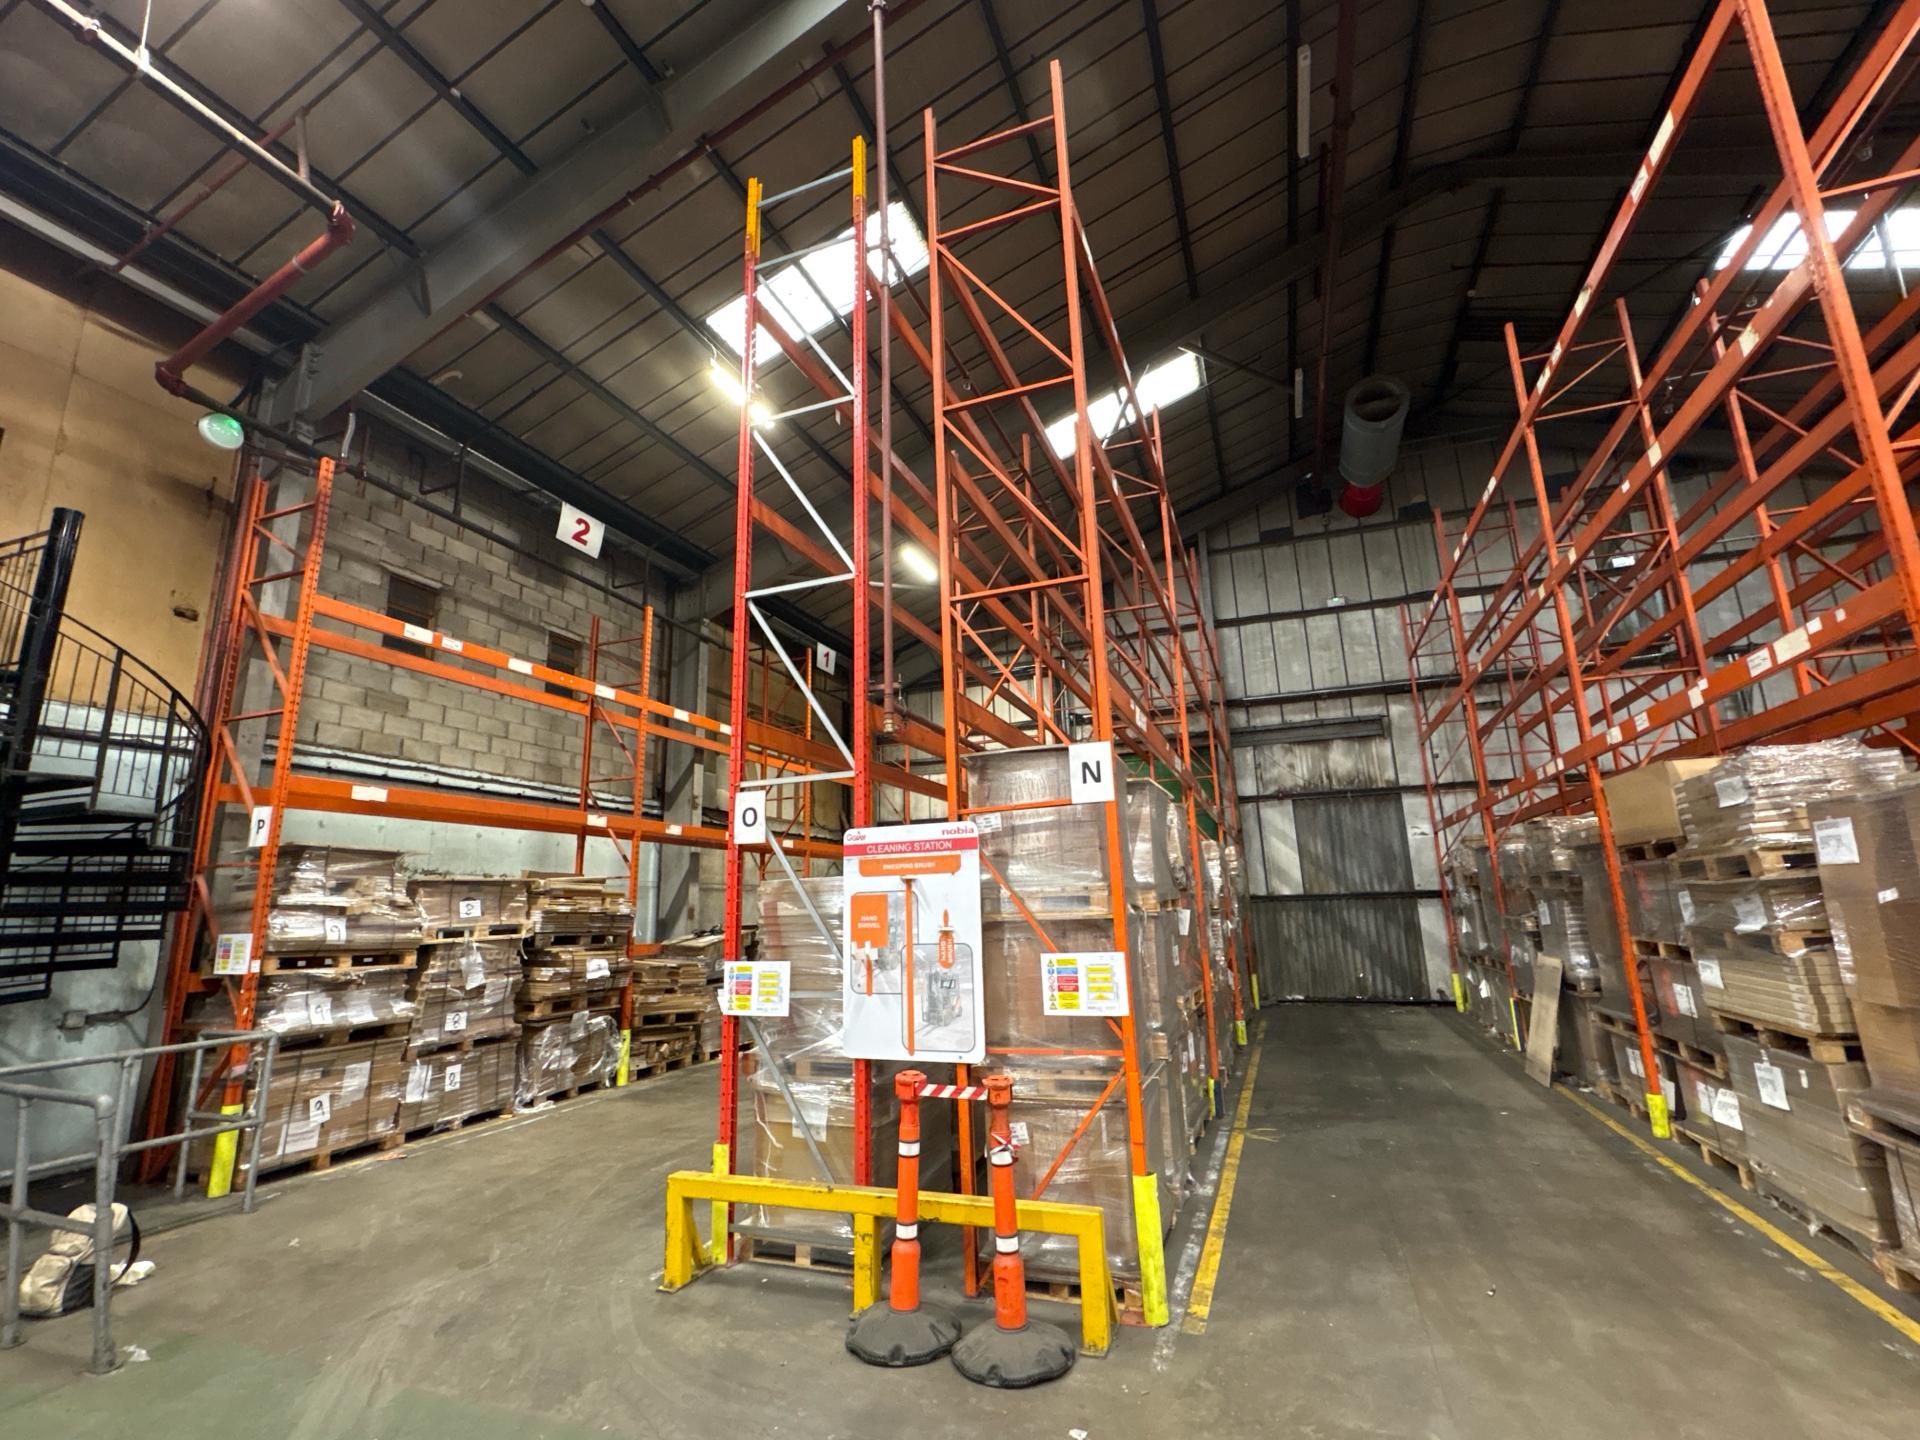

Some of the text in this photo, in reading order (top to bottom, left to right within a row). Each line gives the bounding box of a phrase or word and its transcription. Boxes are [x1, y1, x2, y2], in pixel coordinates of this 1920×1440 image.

[572, 517, 590, 546] 2
[823, 650, 830, 668] 1
[1081, 760, 1101, 784] N
[742, 807, 757, 827] O
[256, 819, 265, 835] P
[942, 825, 975, 836] nobia
[866, 841, 952, 854] CLEANING STATION
